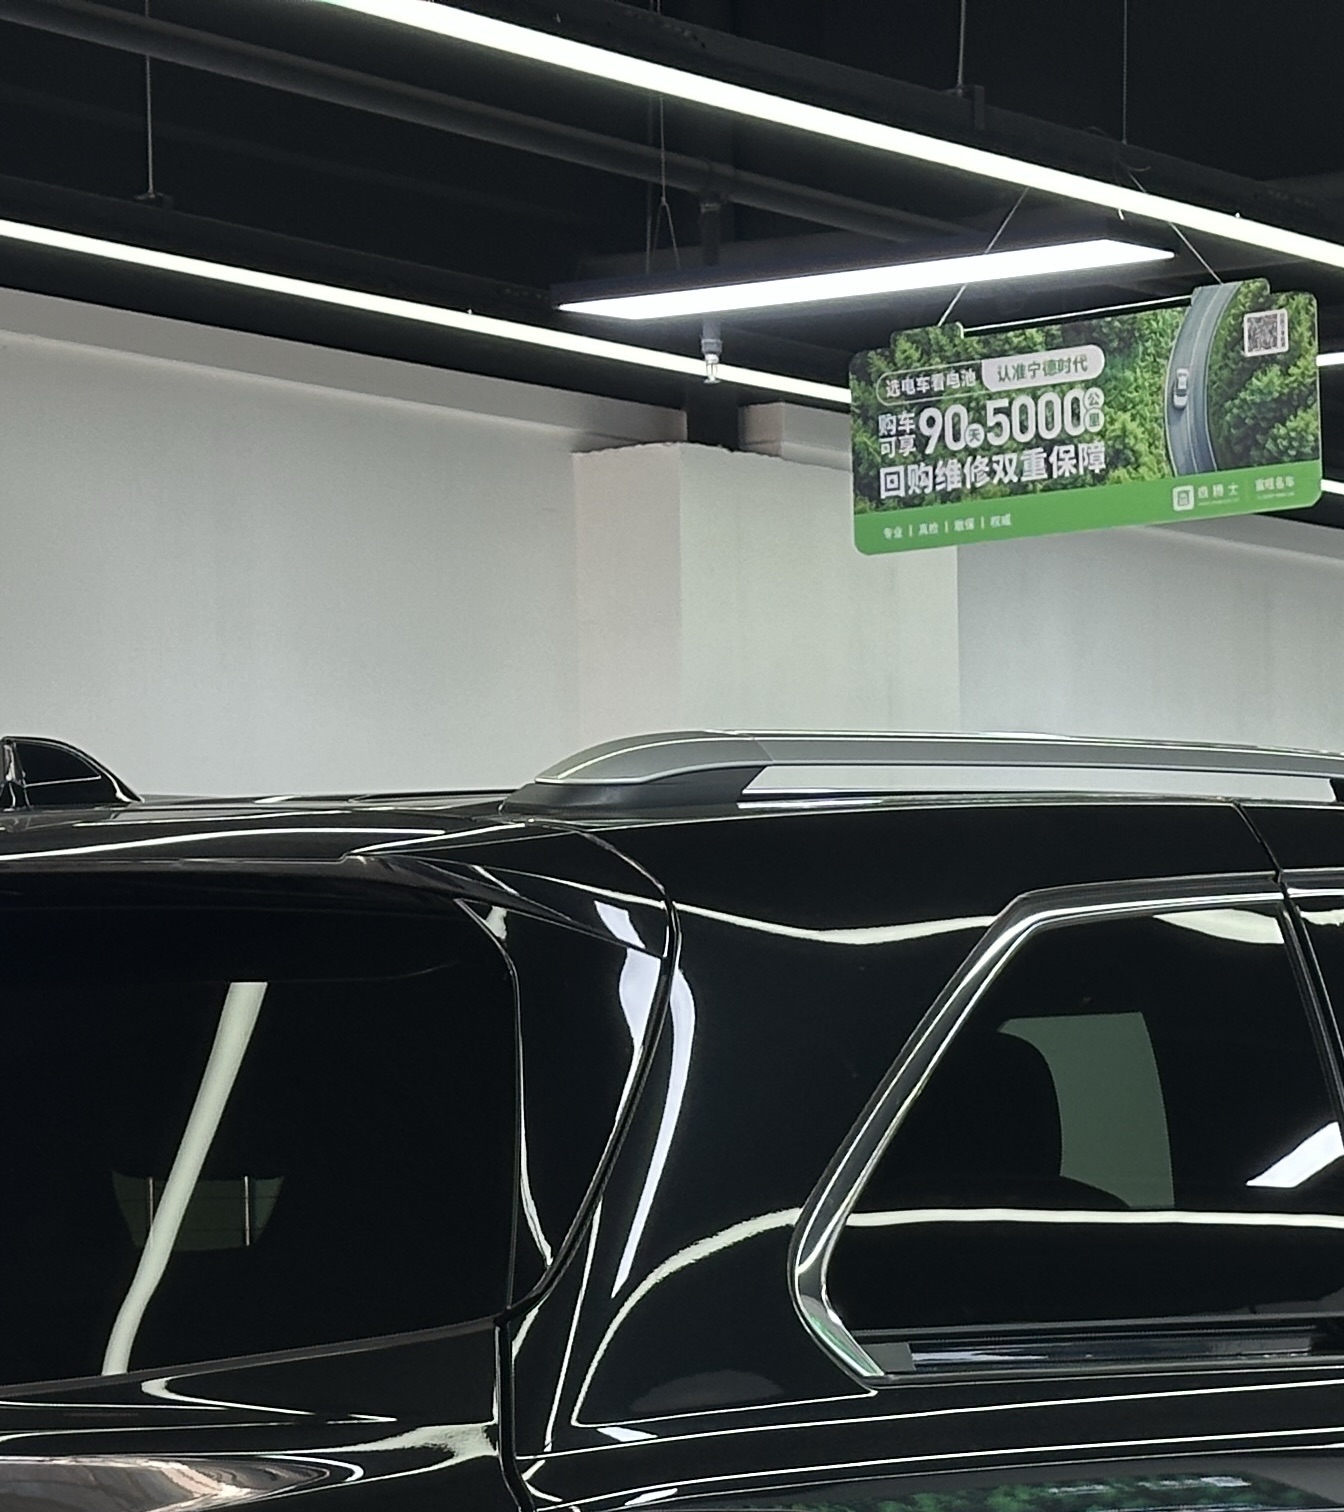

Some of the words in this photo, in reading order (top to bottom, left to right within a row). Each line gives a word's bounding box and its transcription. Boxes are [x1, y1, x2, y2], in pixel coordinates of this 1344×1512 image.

[997, 354, 1088, 383] 认准宁德时代
[885, 370, 977, 398] 选电车看电池
[878, 411, 916, 436] 购车
[918, 404, 969, 455] 90
[986, 388, 1087, 446] 5000
[879, 434, 916, 458] 可享
[879, 440, 1106, 499] 回购维修双重保障
